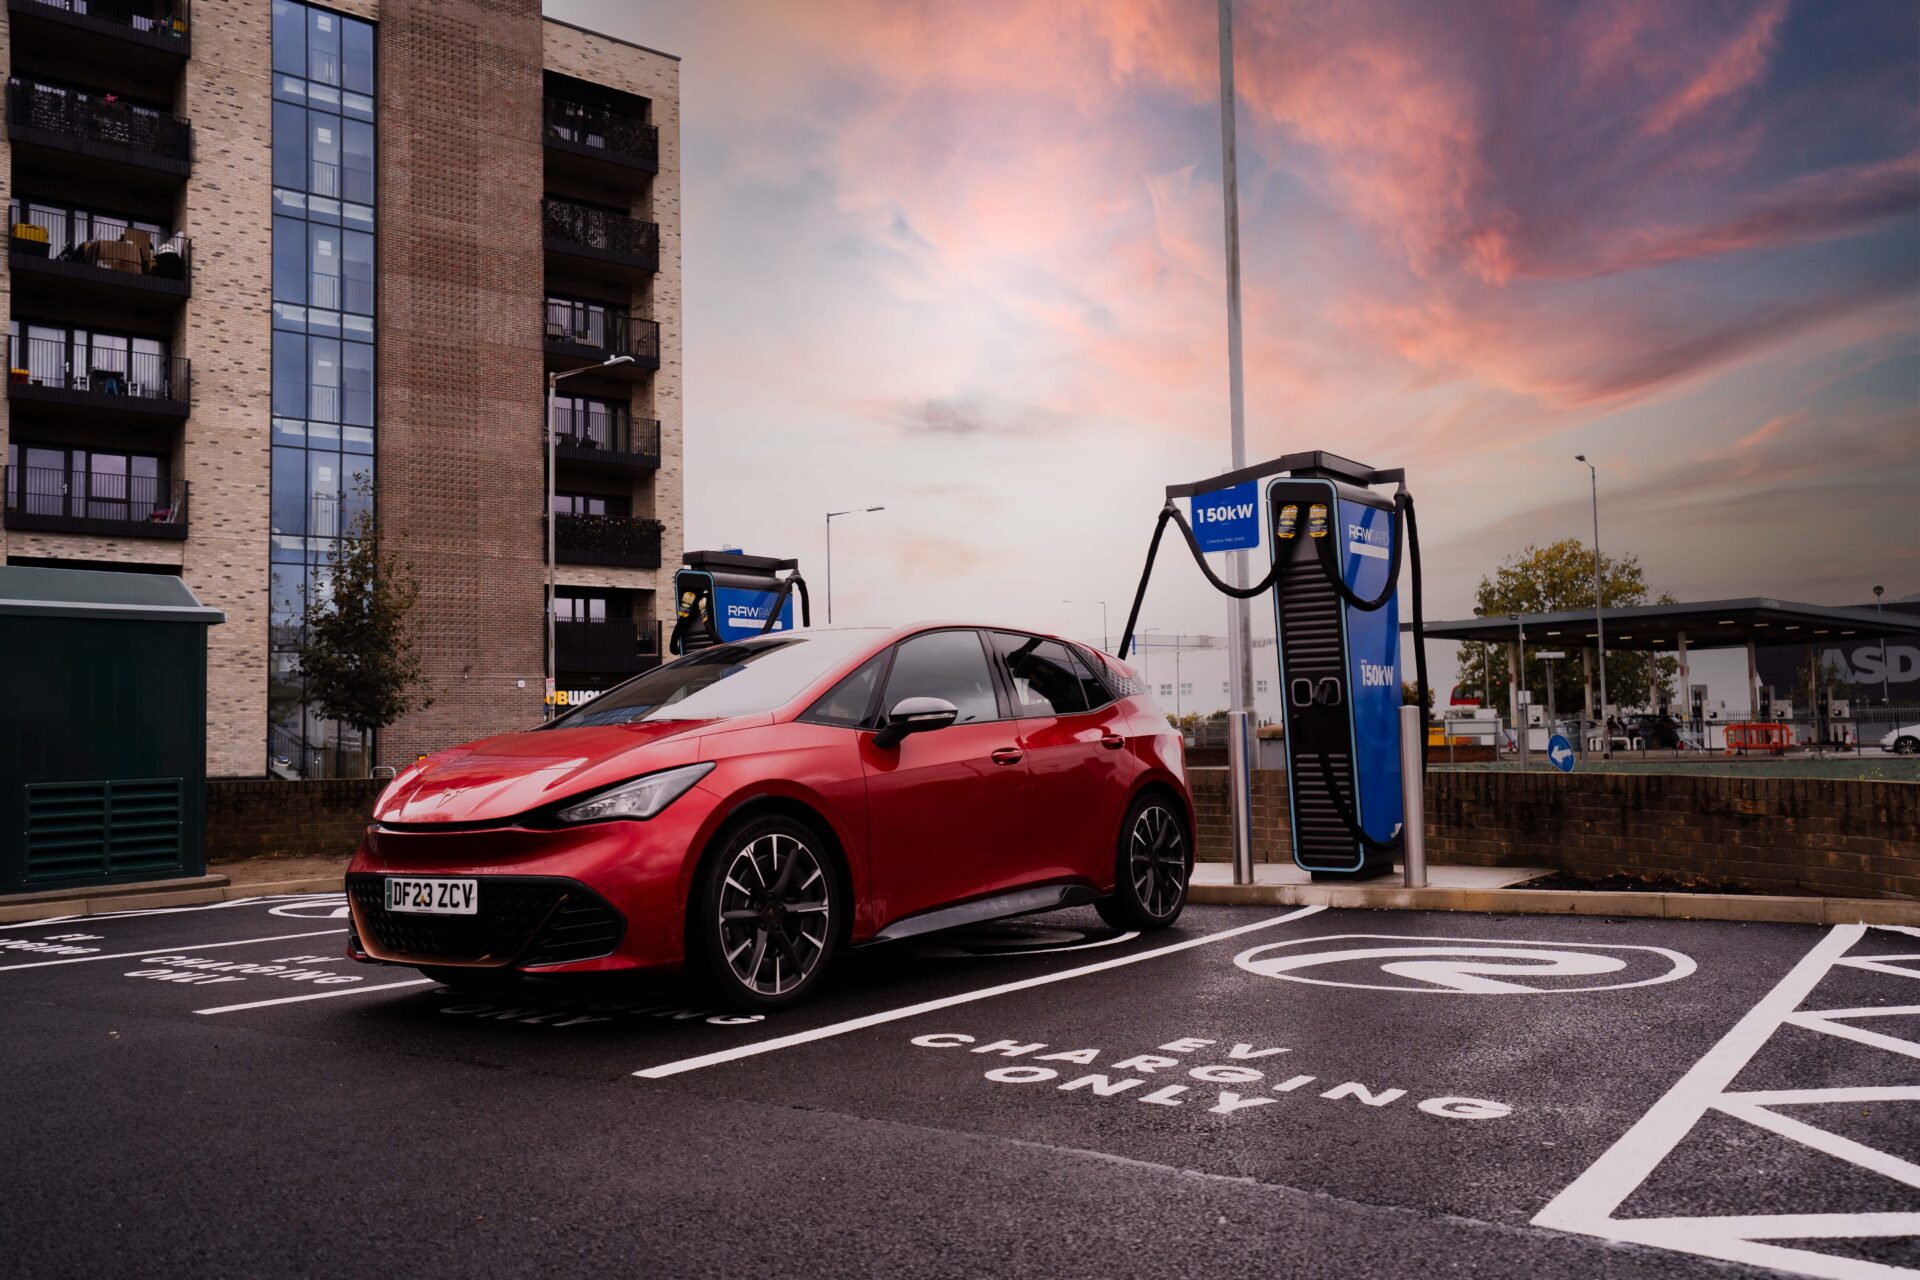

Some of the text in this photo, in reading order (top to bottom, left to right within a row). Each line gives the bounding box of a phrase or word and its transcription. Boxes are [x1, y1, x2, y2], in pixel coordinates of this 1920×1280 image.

[1197, 503, 1254, 524] 150kW
[1360, 664, 1394, 686] 150kW
[394, 881, 473, 908] DF23 ZCV
[124, 969, 247, 985] ONLY
[141, 955, 363, 984] CHARGING
[1158, 1036, 1292, 1060] EV
[909, 1033, 1513, 1120] CHARGING
[983, 1065, 1278, 1115] ONLY
